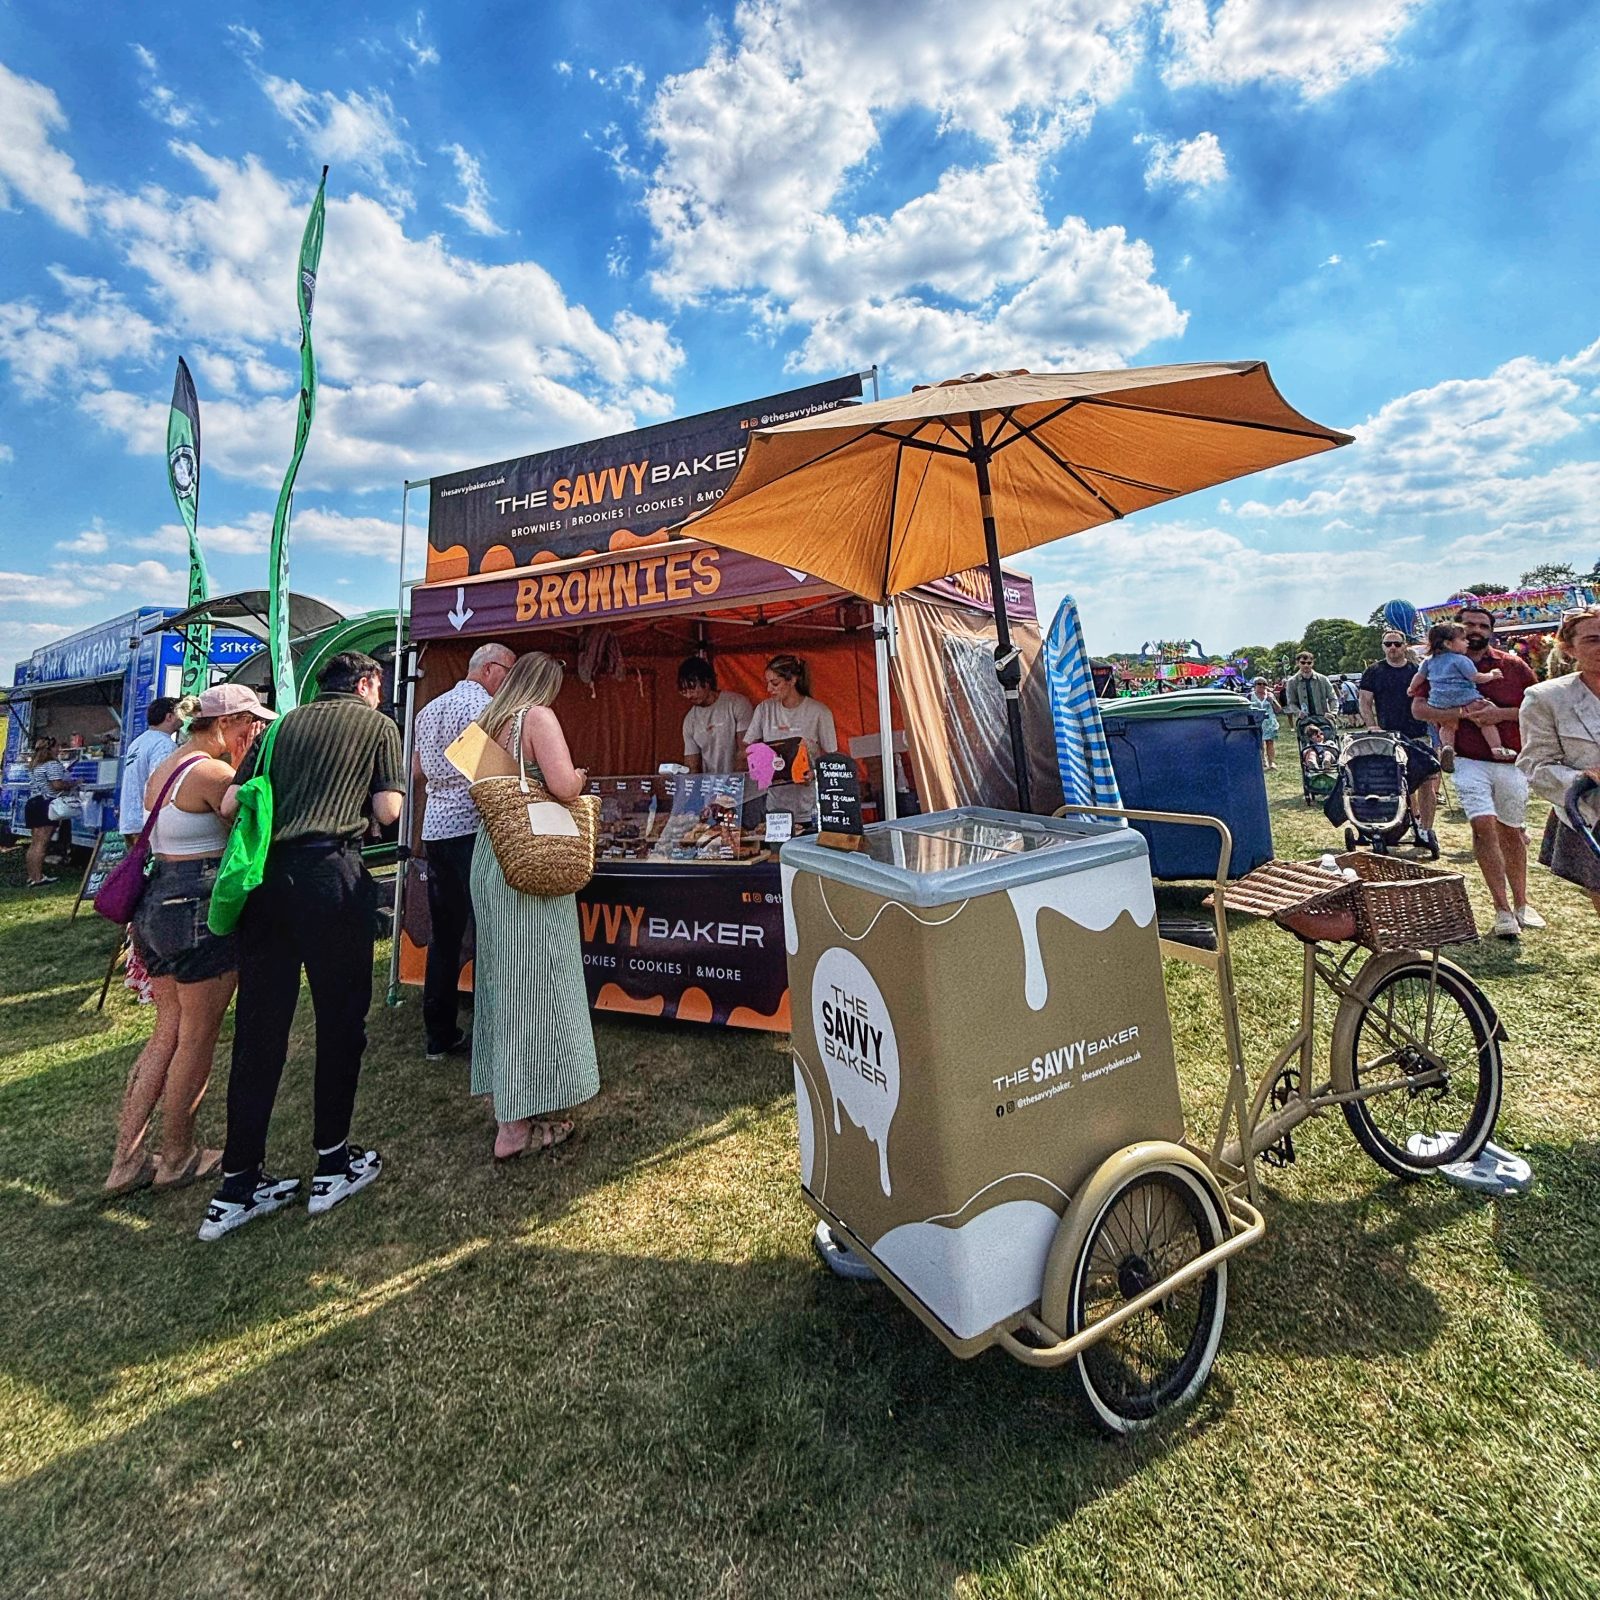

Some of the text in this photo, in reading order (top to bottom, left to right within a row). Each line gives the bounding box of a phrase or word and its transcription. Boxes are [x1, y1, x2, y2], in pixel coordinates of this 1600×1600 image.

[440, 476, 506, 498] thesavvybaker.co.uk
[495, 490, 548, 515] THE
[552, 460, 649, 511] SAVVY
[511, 487, 728, 538] BROWNIES BROOKIES COOKIES &MO
[515, 548, 721, 622] BROWNIES
[829, 778, 839, 787] £5
[842, 817, 851, 826] £2
[580, 902, 765, 949] VVY BAKER
[583, 954, 742, 981] OKIES COOKIES &MORE
[830, 984, 869, 1021] THE
[822, 1000, 883, 1068] SAVVY
[824, 1036, 889, 1094] BAKER
[992, 1025, 1140, 1092] THE SAVVY BAKER
[1081, 1050, 1142, 1082] thesavvybaker.co.uk
